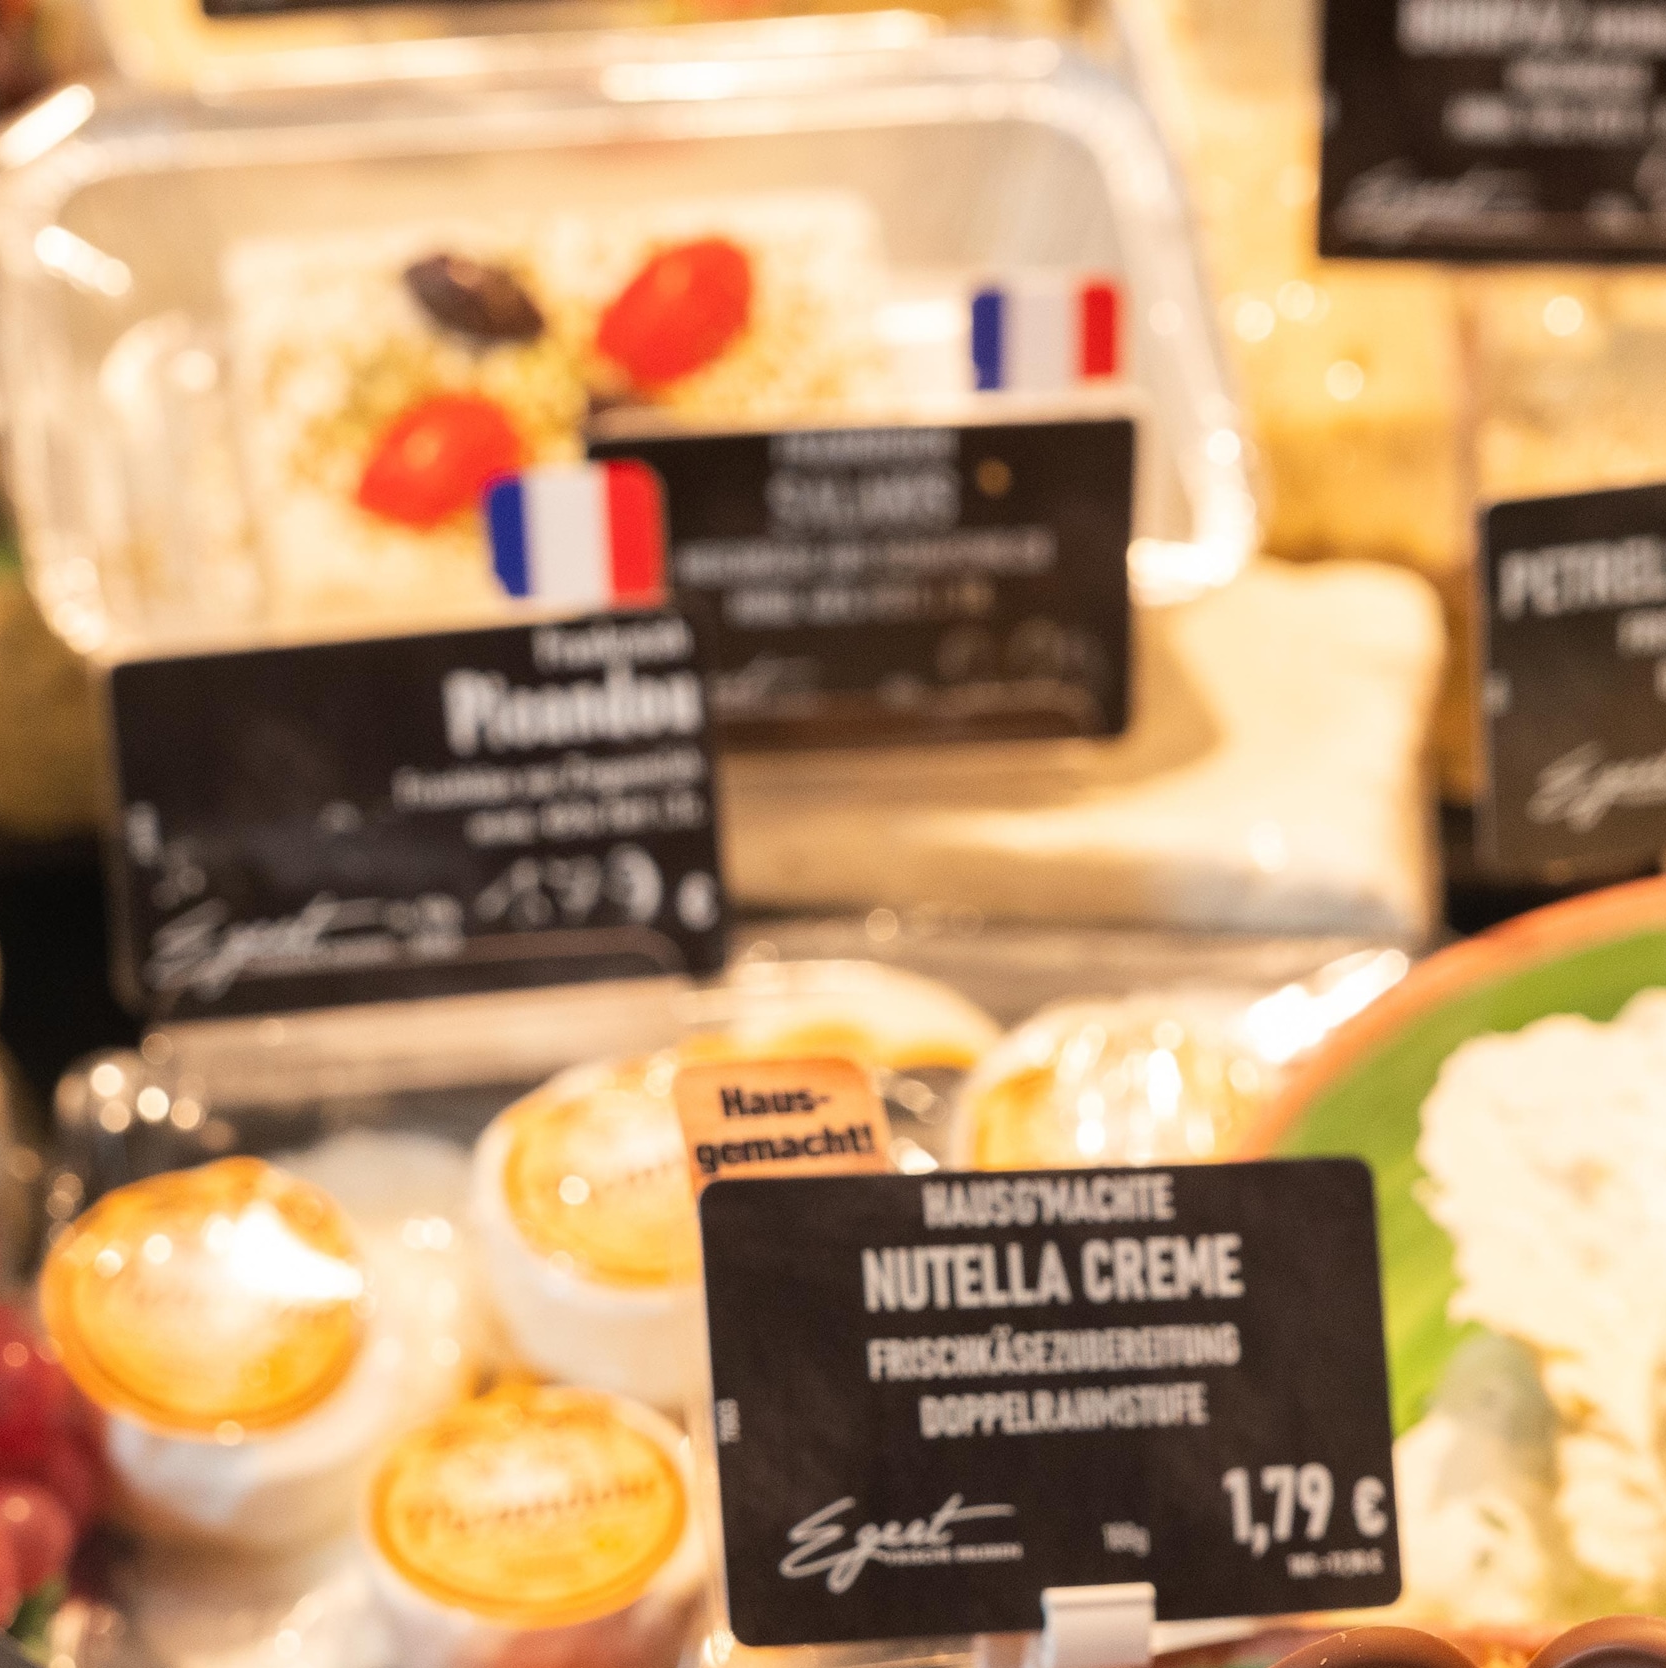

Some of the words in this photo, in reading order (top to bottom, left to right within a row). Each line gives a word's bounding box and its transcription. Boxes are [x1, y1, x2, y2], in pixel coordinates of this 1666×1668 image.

[720, 1083, 830, 1120] Haus-
[696, 1125, 874, 1174] gemacht!
[861, 1242, 1073, 1313] NUTELLA
[1080, 1233, 1246, 1302] CREME
[866, 1323, 1242, 1382] FRISCHKÄSEZUBEREITUNG
[918, 1381, 1208, 1439] DOPPELRAHMSTUFE
[1221, 1461, 1334, 1558] 1,79
[1352, 1475, 1388, 1538] €
